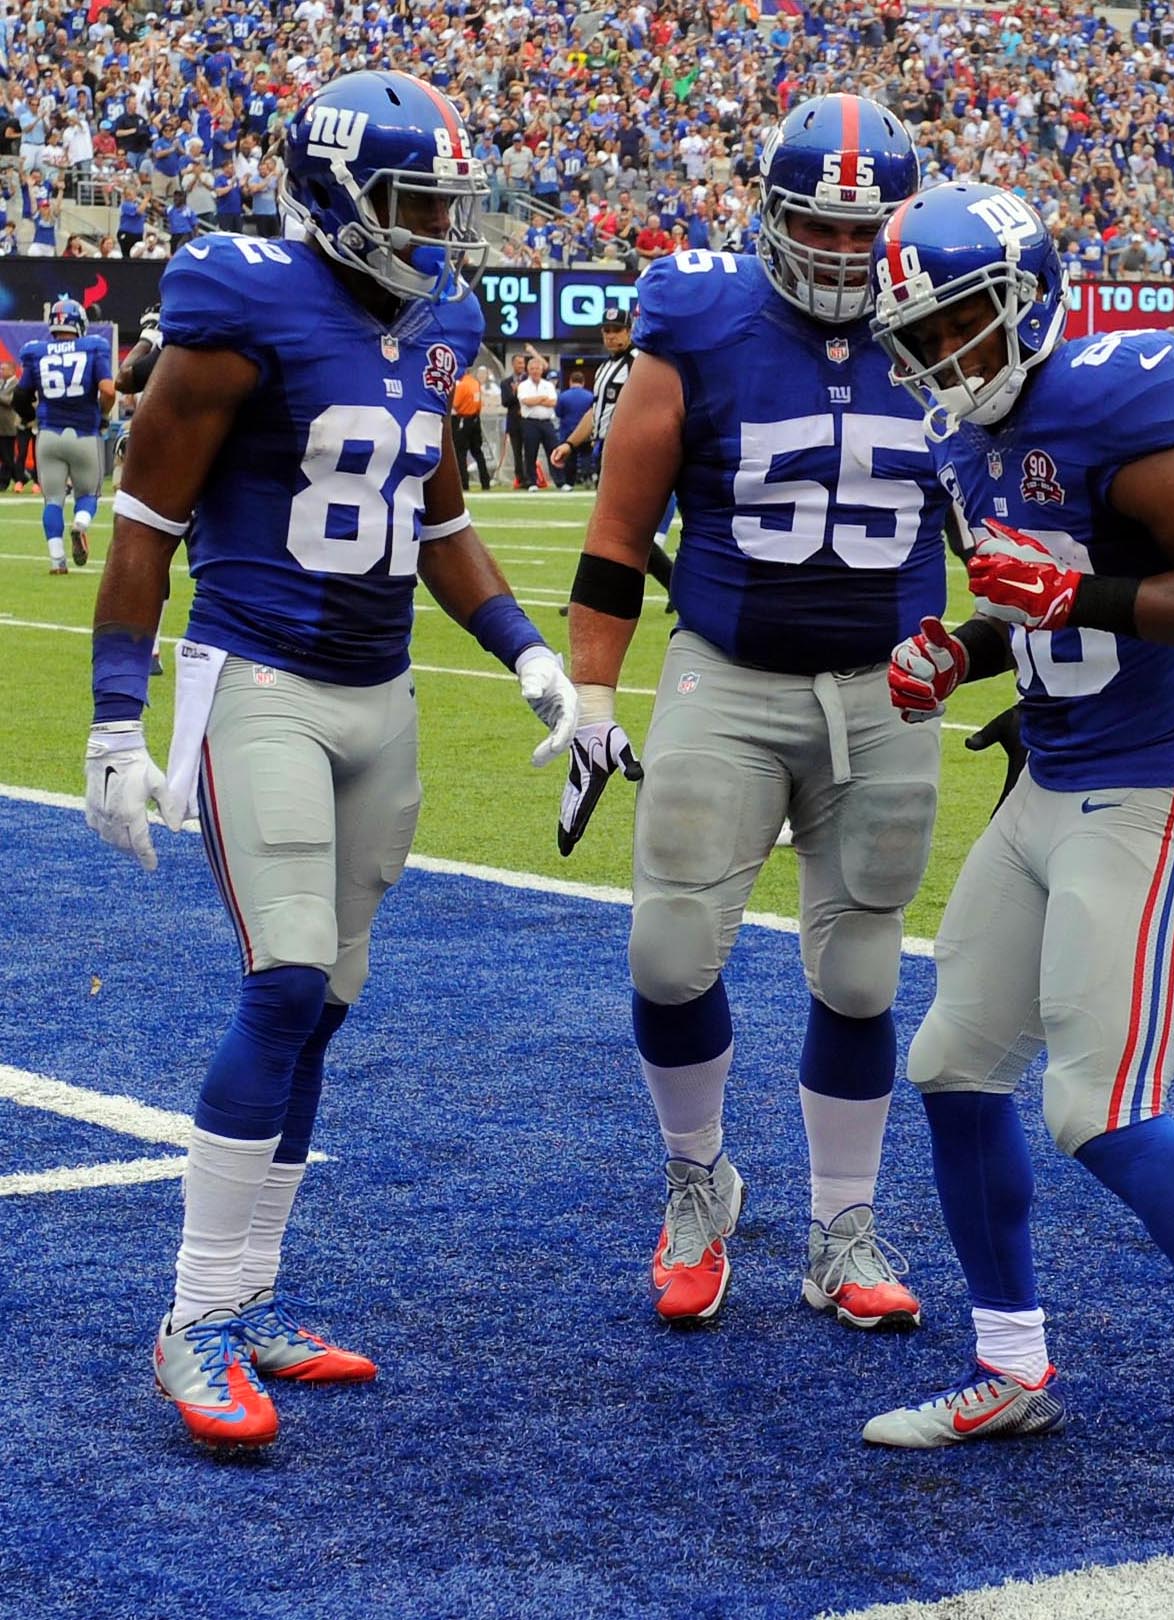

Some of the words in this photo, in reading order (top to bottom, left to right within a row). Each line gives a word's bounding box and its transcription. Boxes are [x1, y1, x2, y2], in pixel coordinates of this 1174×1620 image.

[249, 100, 263, 116] 10
[434, 127, 473, 158] 82
[564, 158, 581, 177] 10
[822, 154, 875, 187] 55
[876, 245, 921, 292] 80
[482, 276, 537, 303] TOL
[1098, 286, 1133, 311] TO
[1138, 287, 1174, 312] GO
[500, 304, 519, 335] 3
[47, 340, 75, 353] PUGH
[435, 348, 453, 371] 90
[39, 351, 87, 399] 67
[1029, 455, 1047, 478] 90
[287, 405, 444, 576] 82
[732, 413, 930, 569] 55
